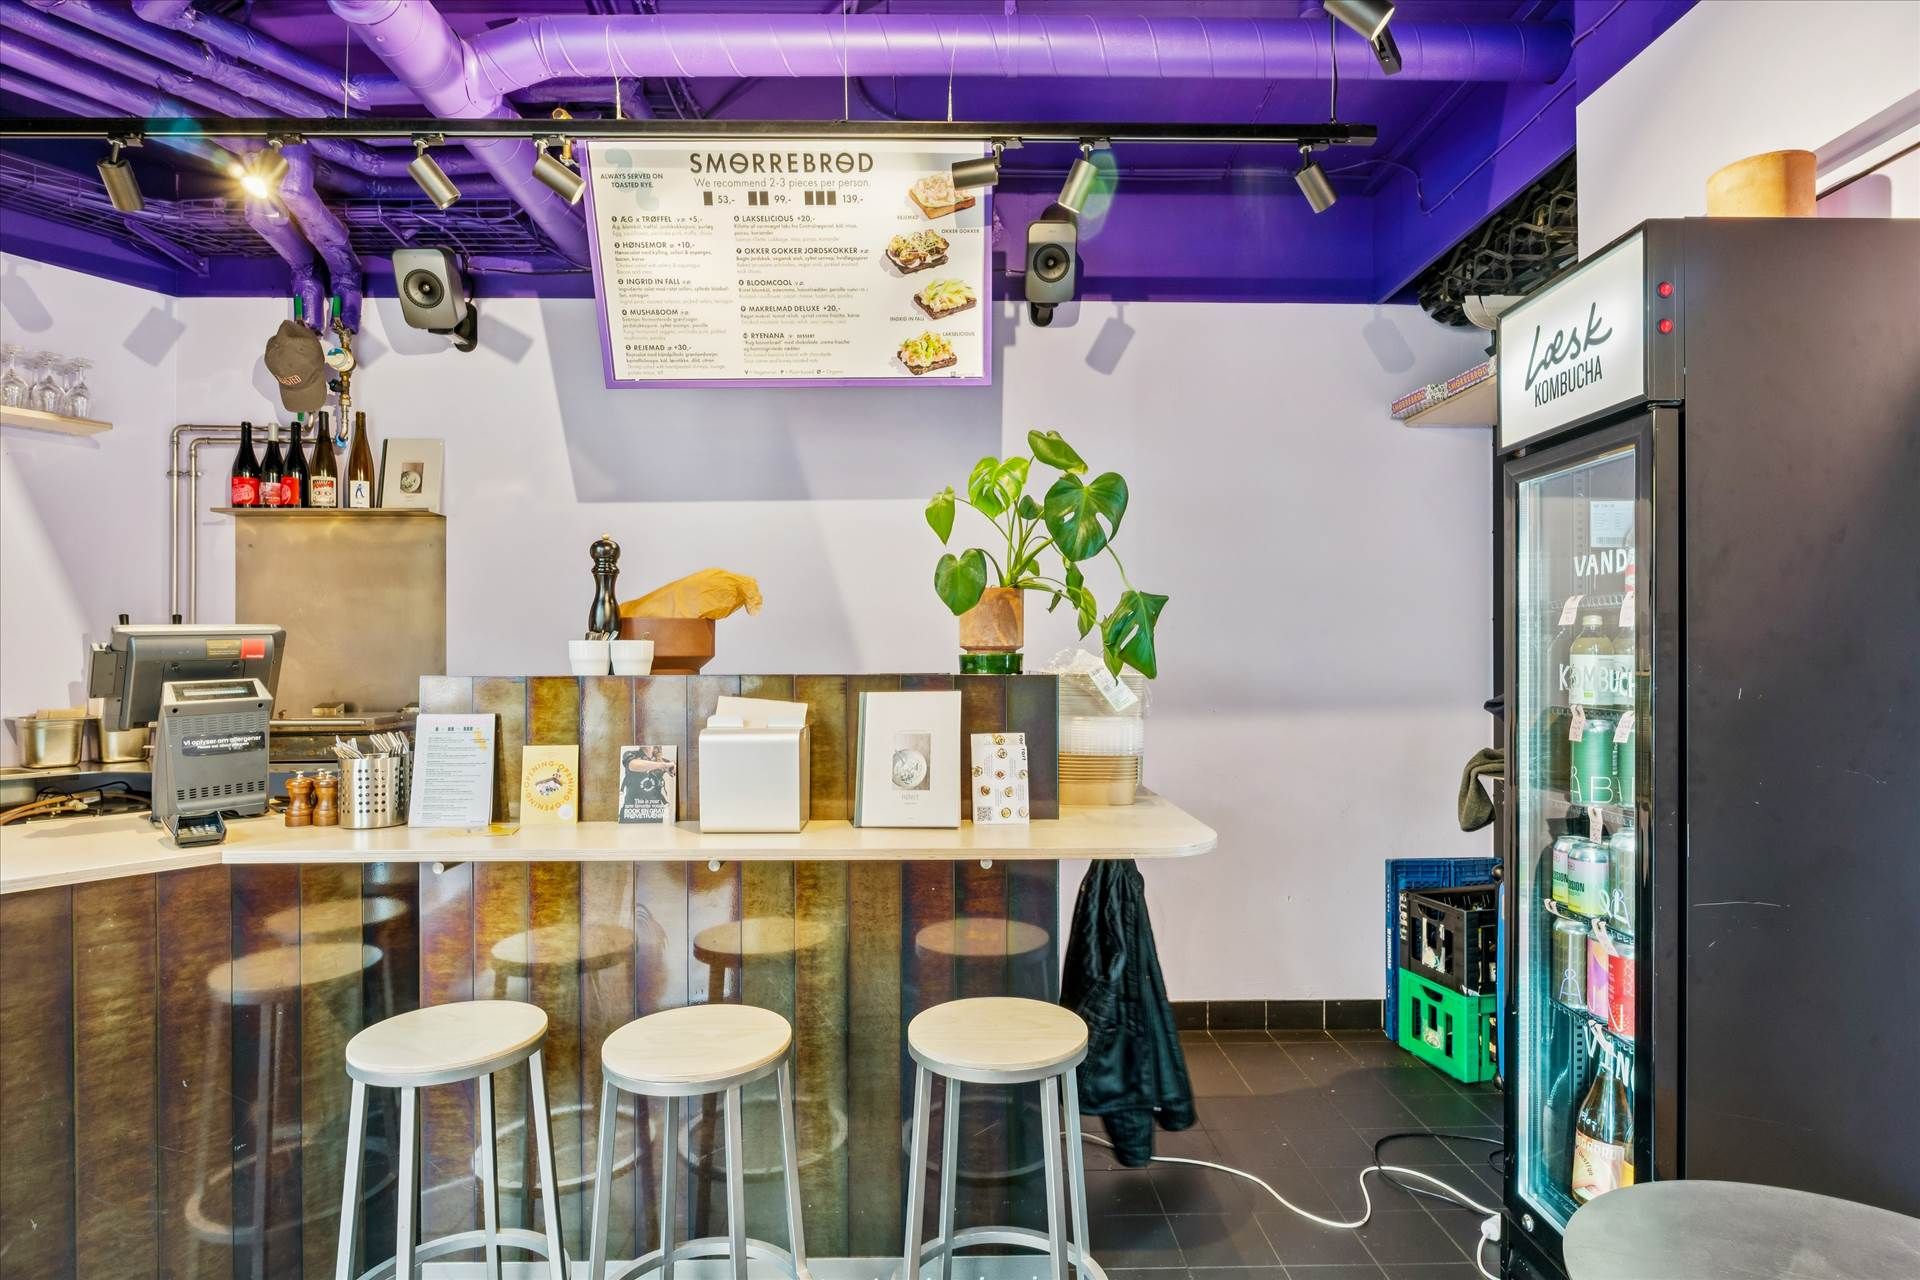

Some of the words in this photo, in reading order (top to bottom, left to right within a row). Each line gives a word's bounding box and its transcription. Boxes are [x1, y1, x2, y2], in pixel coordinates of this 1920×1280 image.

[689, 152, 874, 174] SMØRREBRØD
[694, 178, 710, 187] We
[713, 178, 767, 187] recommend
[769, 178, 786, 187] 2-3
[788, 178, 819, 190] pieces
[820, 180, 835, 190] per
[838, 180, 871, 190] person.
[717, 195, 736, 205] 53,-
[774, 194, 792, 204] 99,-
[842, 194, 864, 204] 139,-
[1534, 355, 1603, 408] KOMBUCHA
